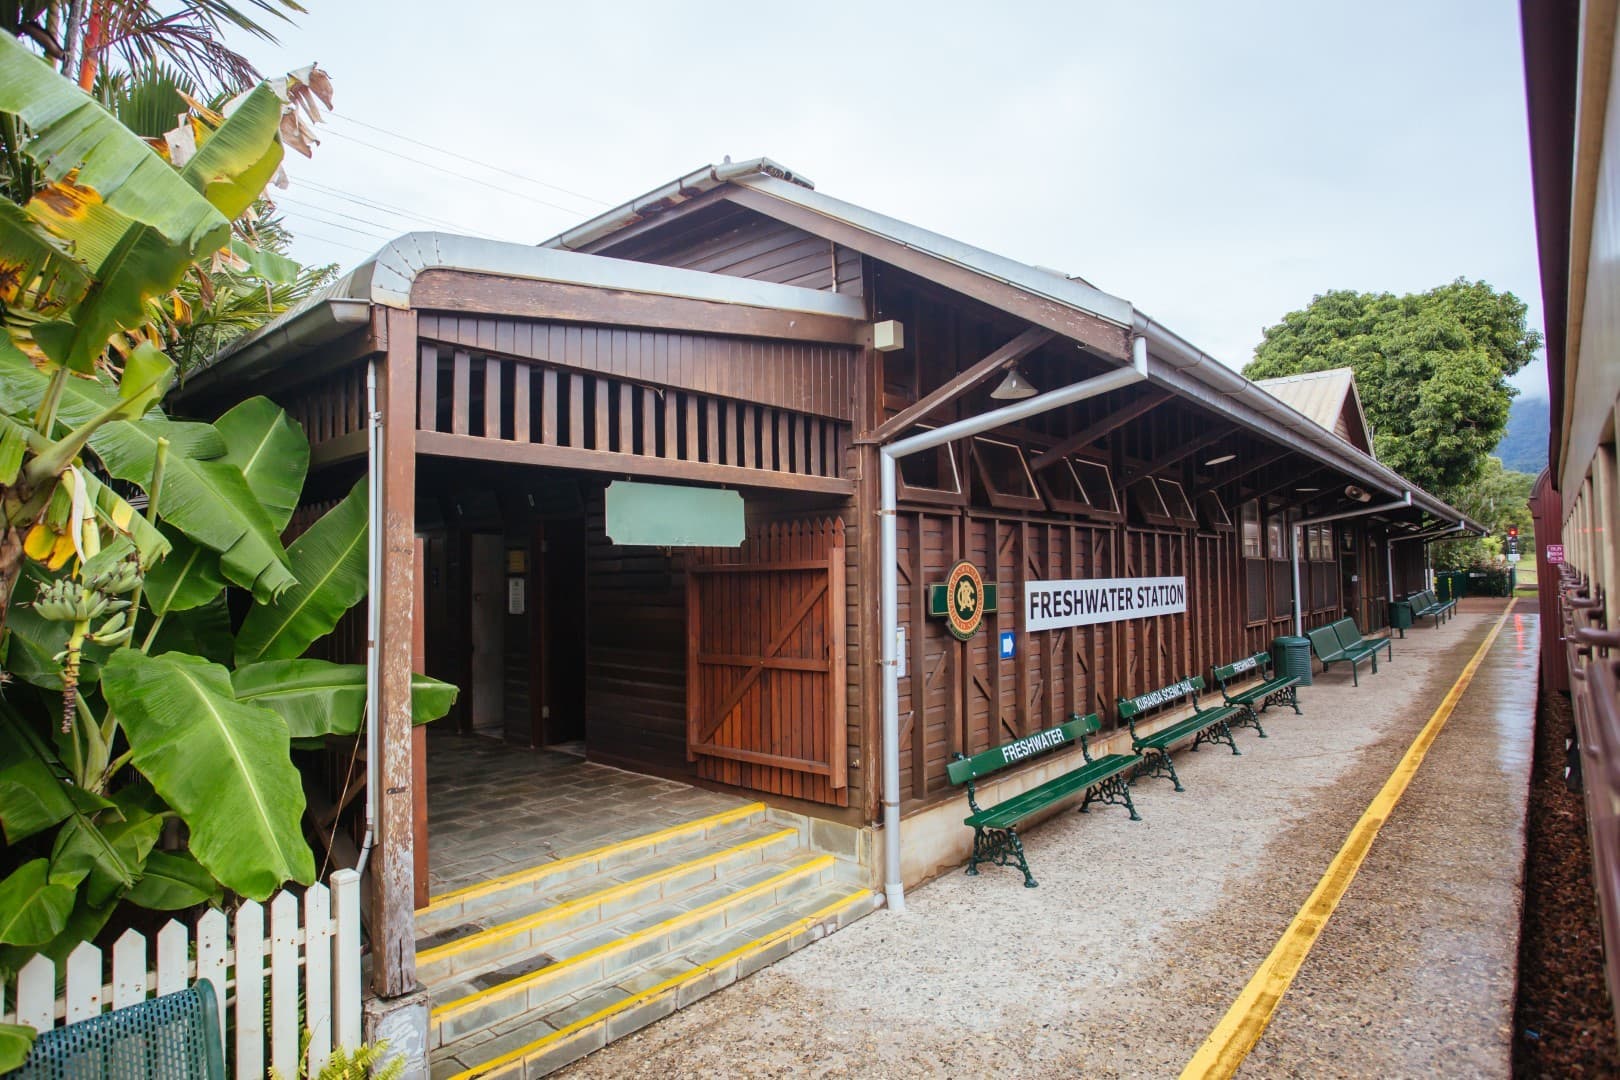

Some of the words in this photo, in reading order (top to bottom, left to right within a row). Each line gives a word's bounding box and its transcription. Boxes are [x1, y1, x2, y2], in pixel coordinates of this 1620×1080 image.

[1030, 587, 1134, 620] FRESHWATER
[1137, 584, 1184, 609] STATION
[1135, 691, 1164, 712] KURANDA
[1001, 728, 1065, 763] FRESHWATER
